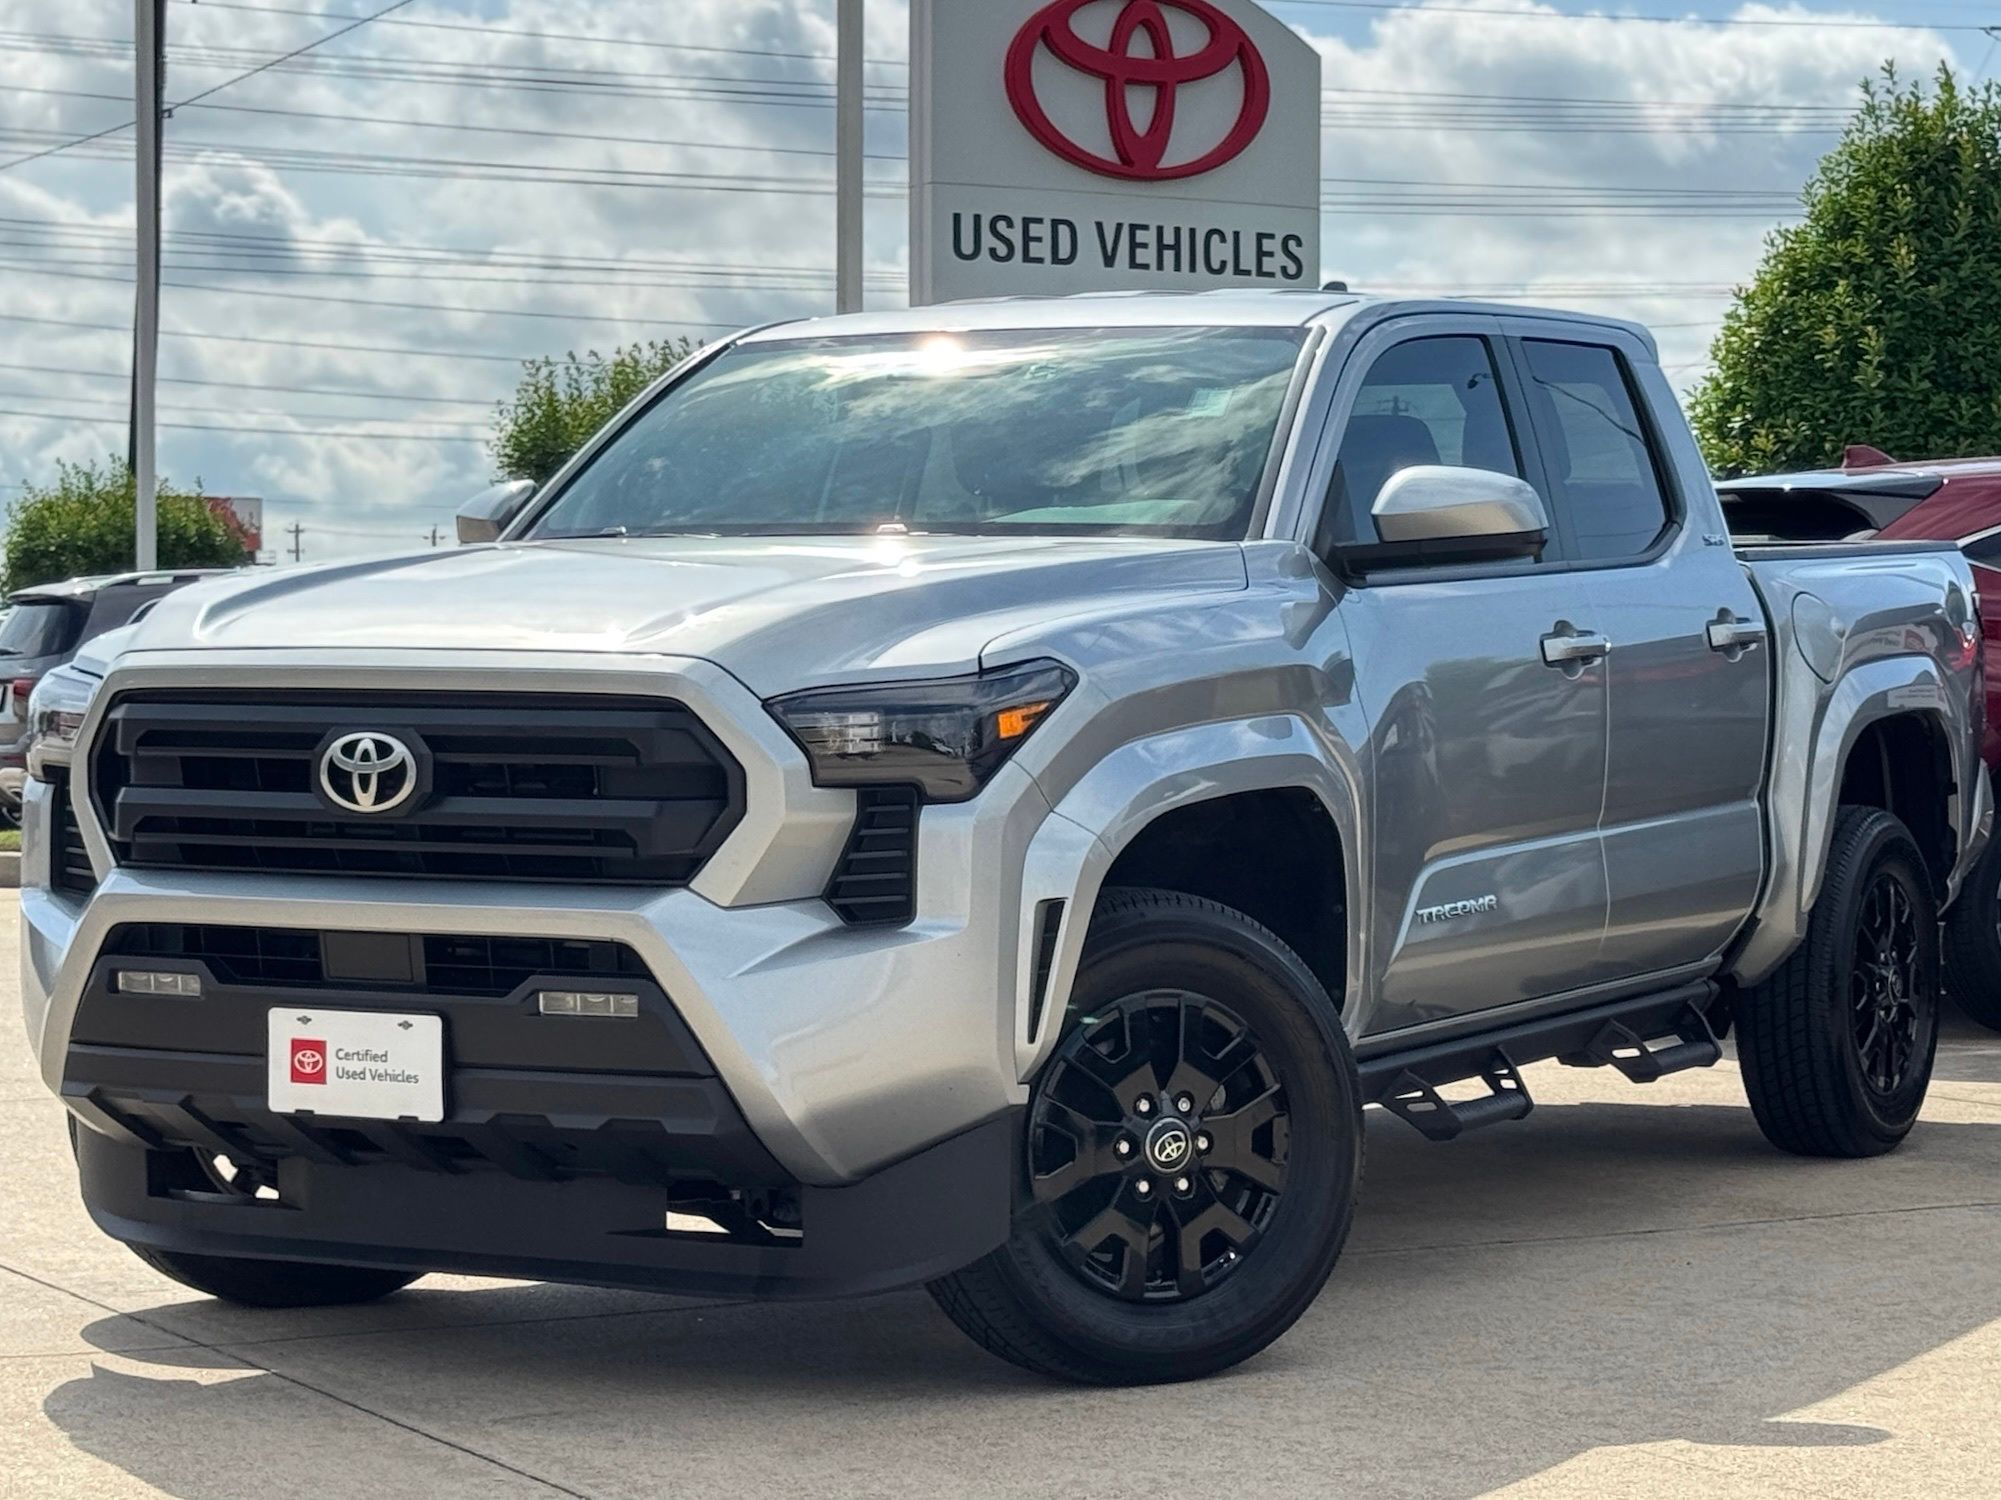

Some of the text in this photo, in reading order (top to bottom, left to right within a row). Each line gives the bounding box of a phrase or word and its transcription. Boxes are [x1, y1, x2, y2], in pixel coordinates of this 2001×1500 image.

[951, 212, 1304, 281] USED VEHICLES
[1416, 894, 1498, 924] TACOMA
[335, 1048, 388, 1063] Certified
[335, 1066, 419, 1084] Used Vehicles
